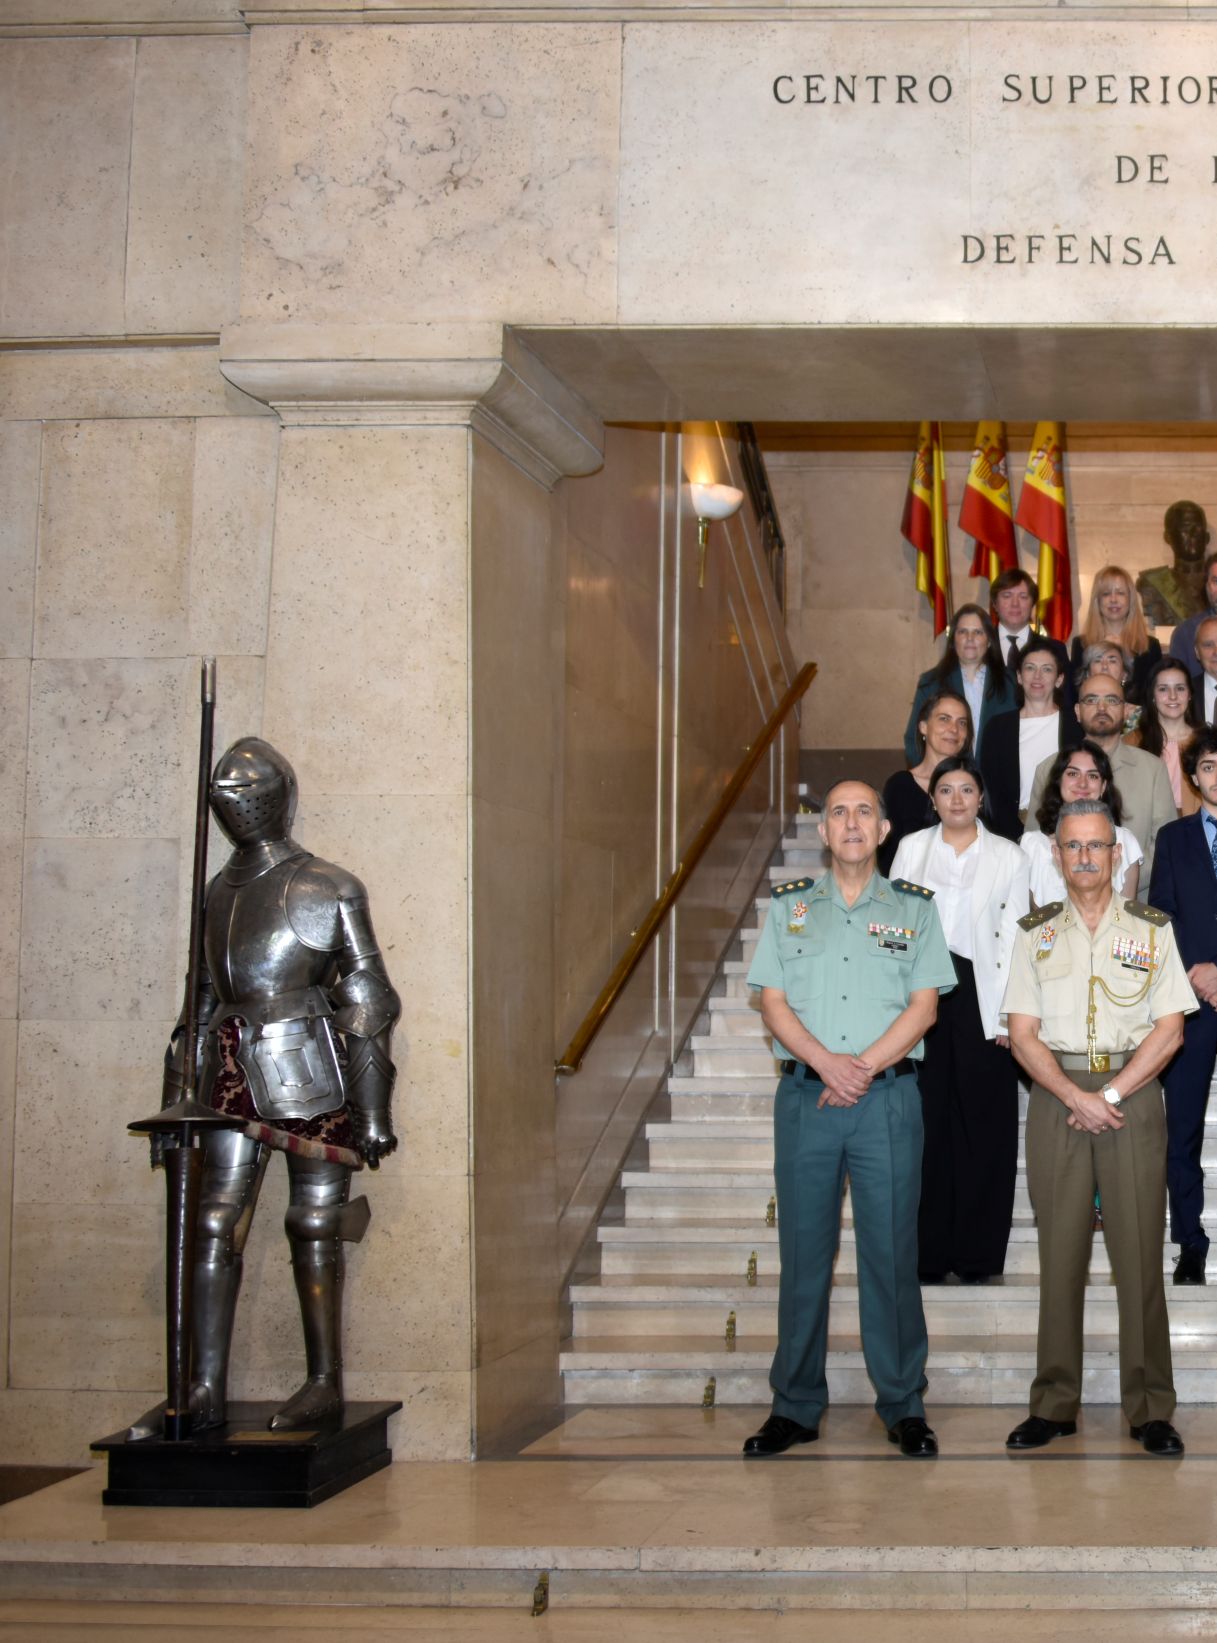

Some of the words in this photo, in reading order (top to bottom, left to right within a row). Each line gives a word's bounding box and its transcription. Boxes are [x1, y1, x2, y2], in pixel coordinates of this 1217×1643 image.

[772, 73, 953, 106] CENTRO
[1115, 154, 1169, 185] DE
[961, 233, 1177, 266] DEFENSA
